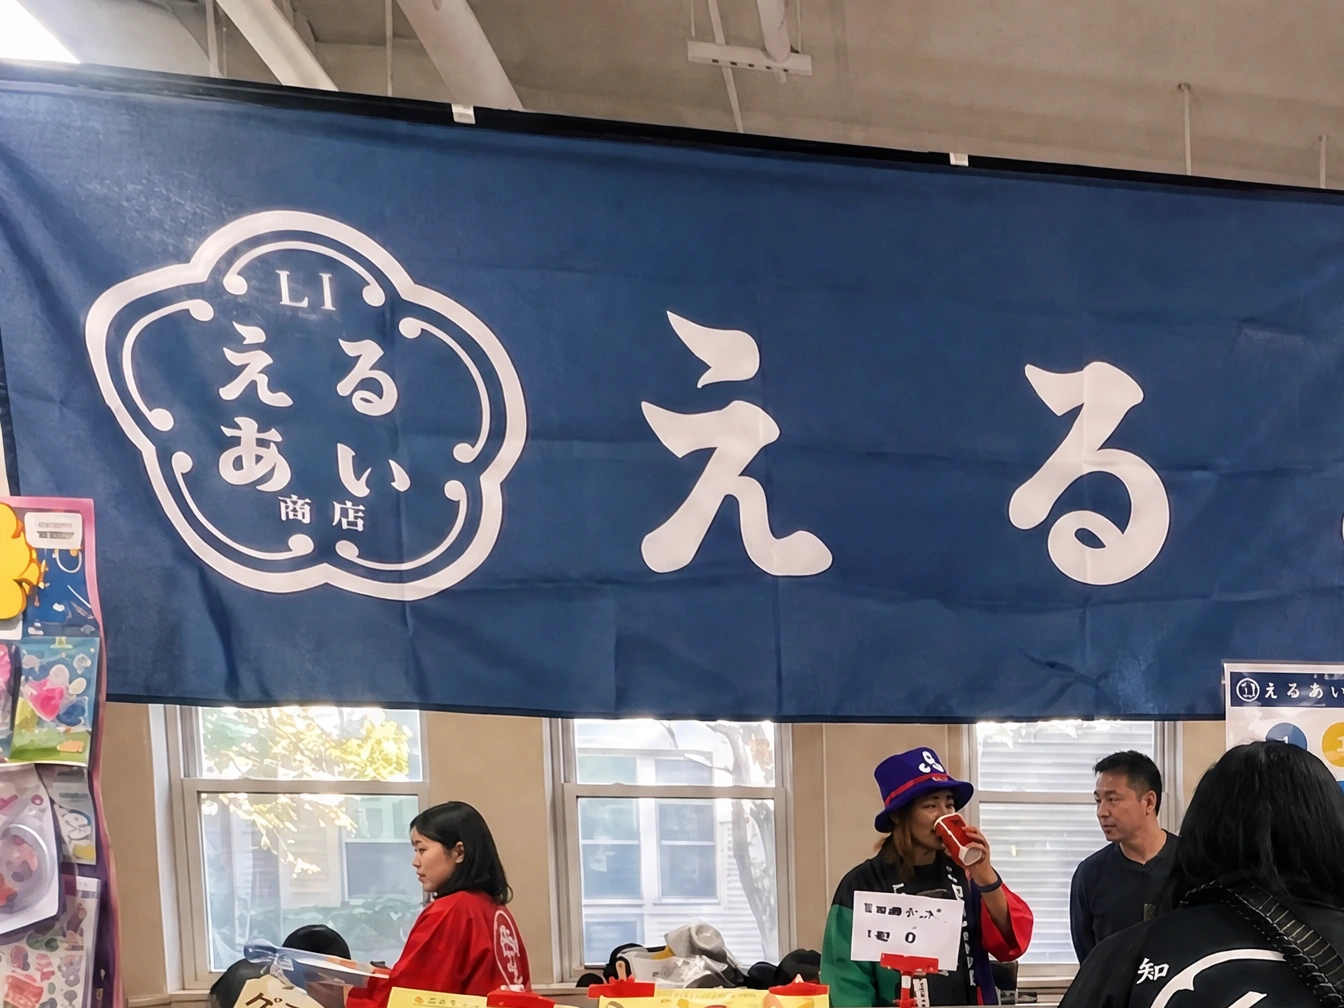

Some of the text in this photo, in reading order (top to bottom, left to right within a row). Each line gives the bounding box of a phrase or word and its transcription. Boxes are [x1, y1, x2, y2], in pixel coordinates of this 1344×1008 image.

[277, 270, 336, 311] LI
[218, 321, 399, 417] える
[218, 417, 411, 498] あい
[279, 495, 366, 532] 商店
[1136, 957, 1169, 985] 知
